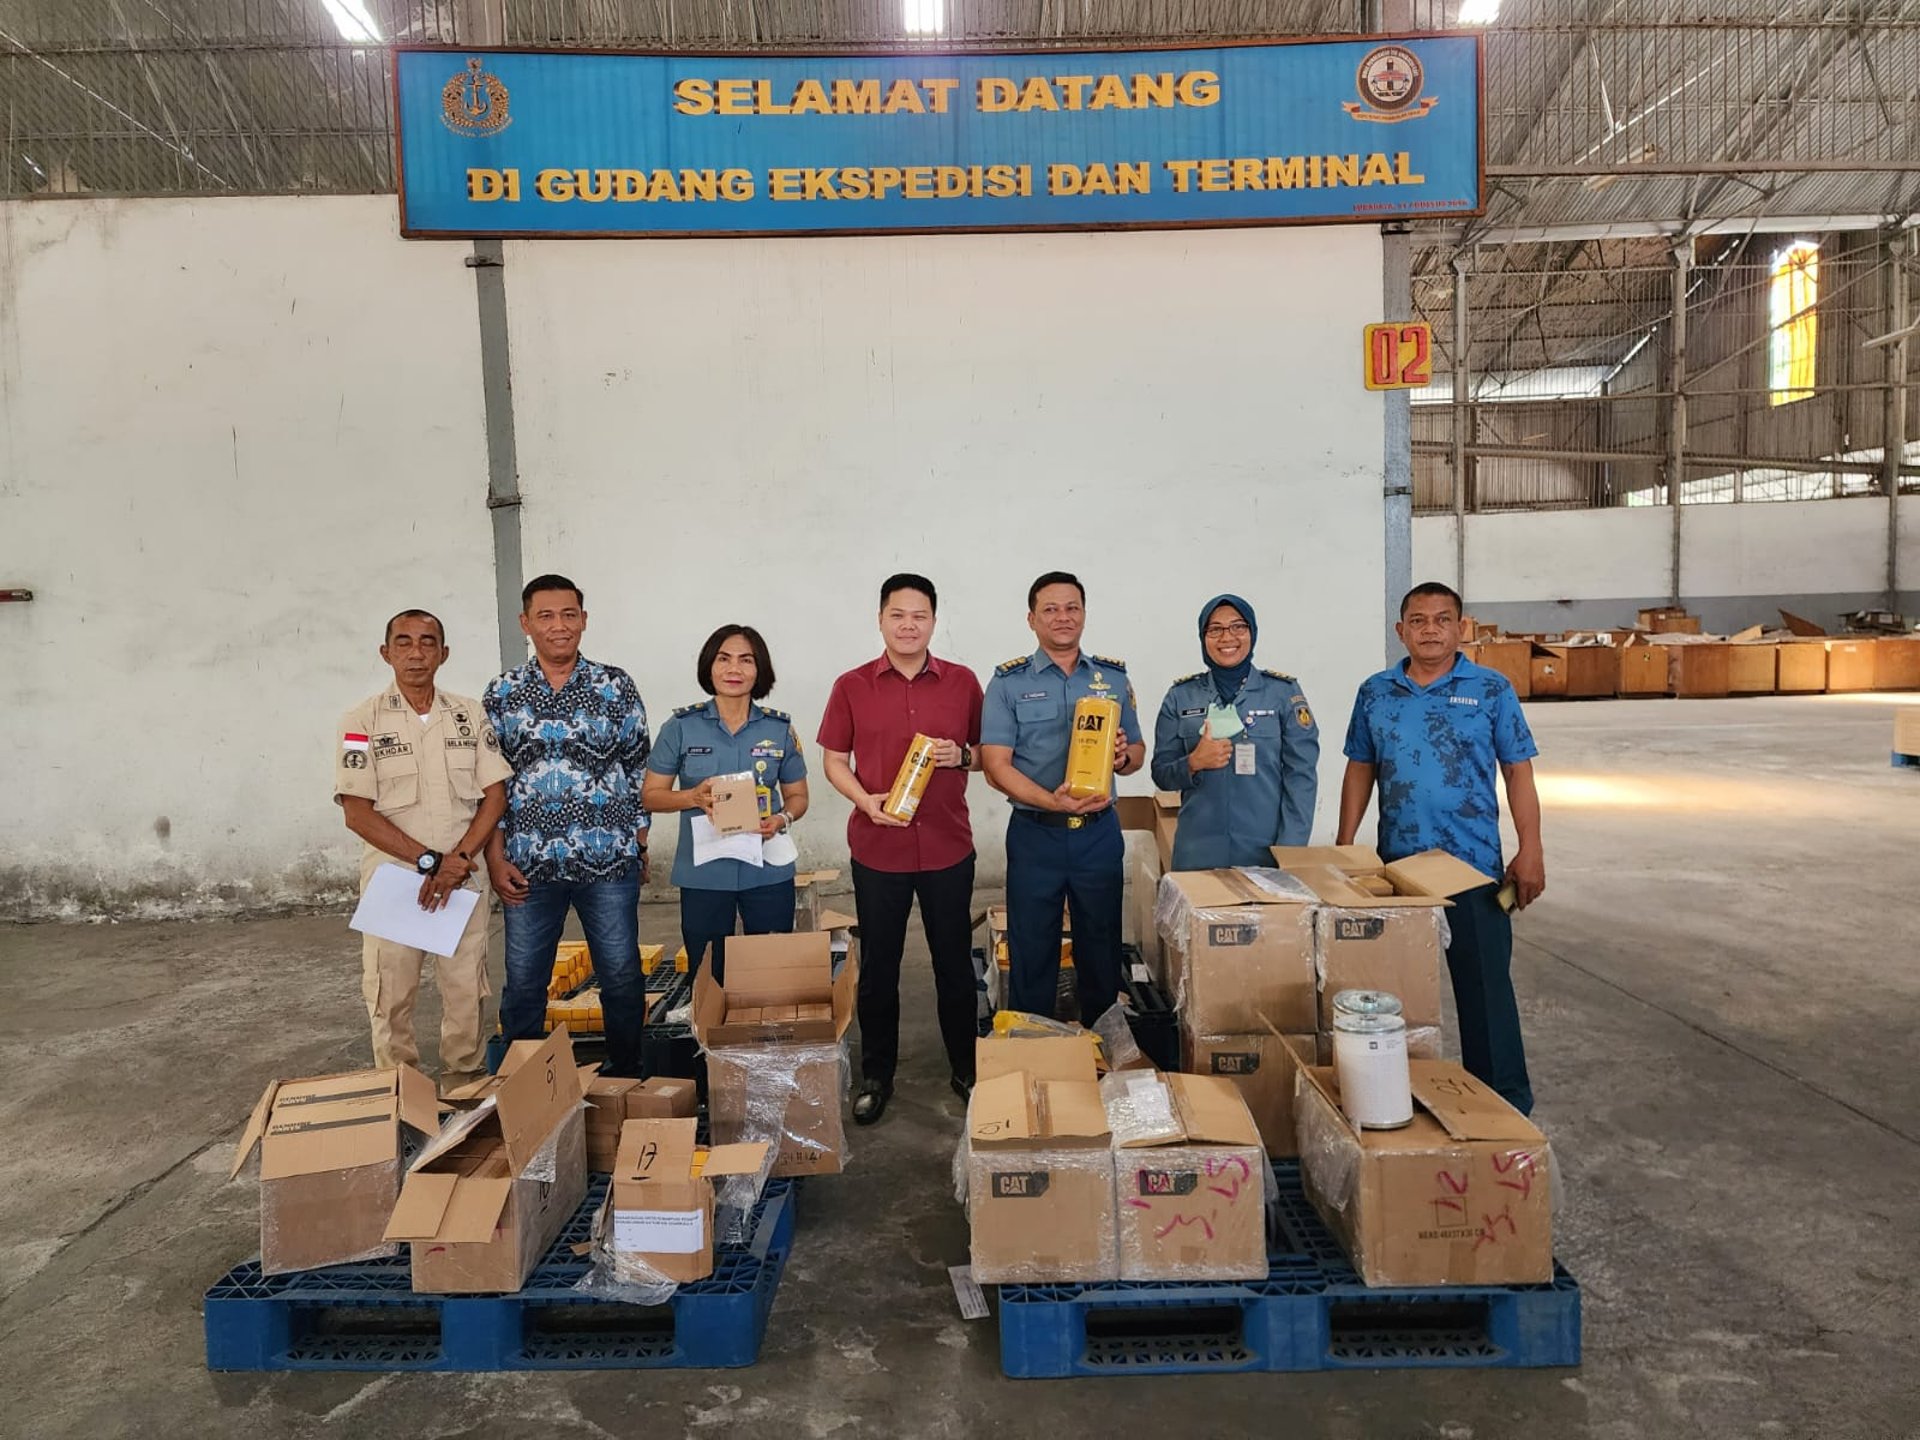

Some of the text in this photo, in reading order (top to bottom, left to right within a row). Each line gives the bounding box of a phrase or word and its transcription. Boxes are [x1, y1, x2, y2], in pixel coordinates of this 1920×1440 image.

[672, 71, 1220, 116] SELAMAT DATANG
[466, 152, 1425, 202] DI GUDANG EKSPEDISI DAN TERMINAL
[1372, 326, 1429, 384] 02
[1077, 714, 1105, 731] CAT
[911, 752, 932, 768] CAT
[1215, 927, 1240, 943] CAT
[1341, 921, 1366, 937] CAT
[1218, 1056, 1243, 1071] CAT
[637, 1142, 657, 1171] 17
[1000, 1175, 1028, 1194] CAT
[1147, 1174, 1177, 1193] CAT
